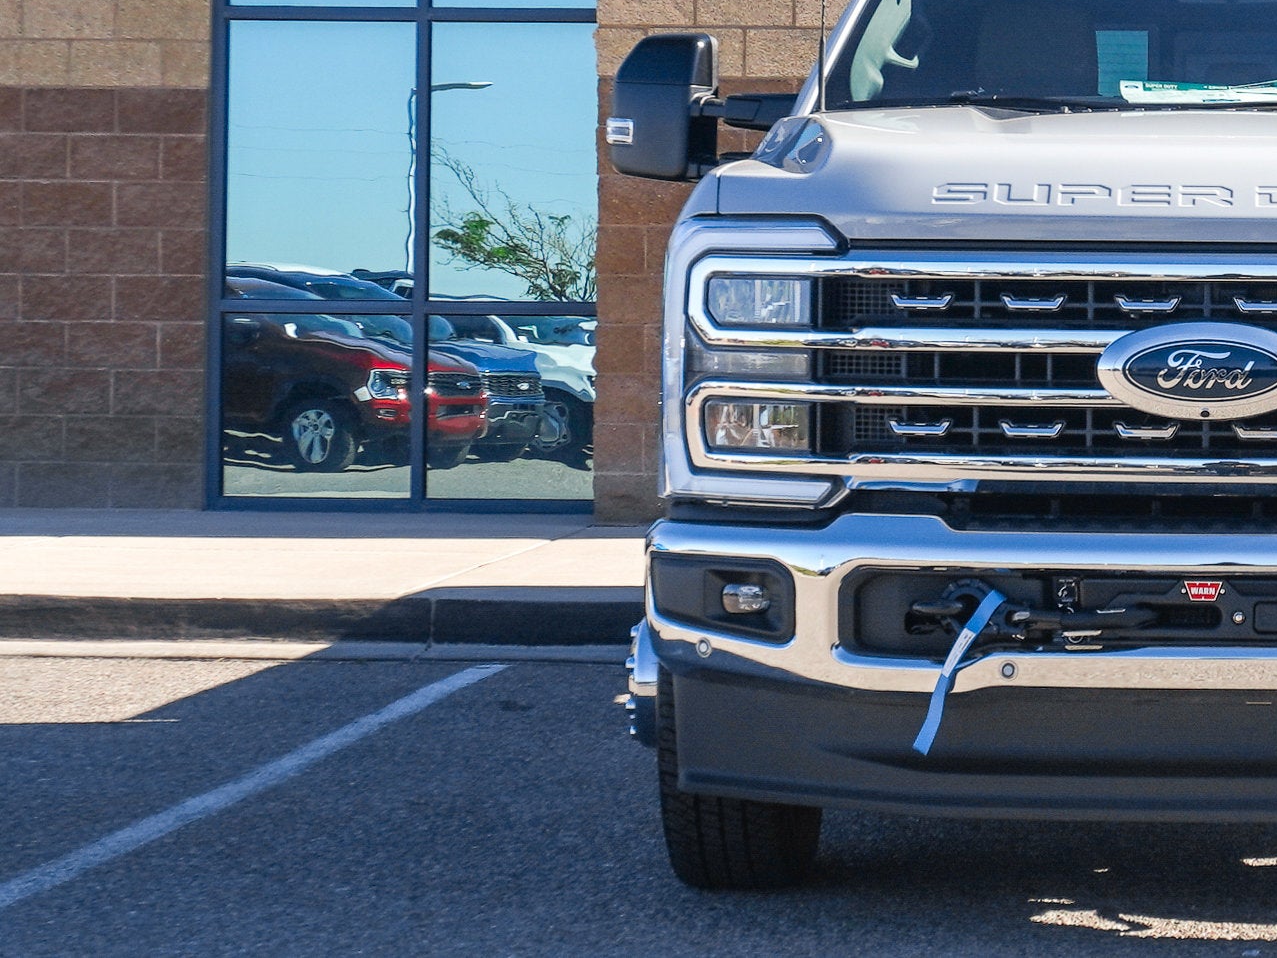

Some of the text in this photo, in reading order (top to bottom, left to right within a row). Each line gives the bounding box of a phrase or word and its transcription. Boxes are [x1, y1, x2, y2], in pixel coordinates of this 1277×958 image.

[931, 182, 1233, 208] SUPER
[1157, 349, 1255, 390] Ford
[1190, 587, 1216, 595] WARN
